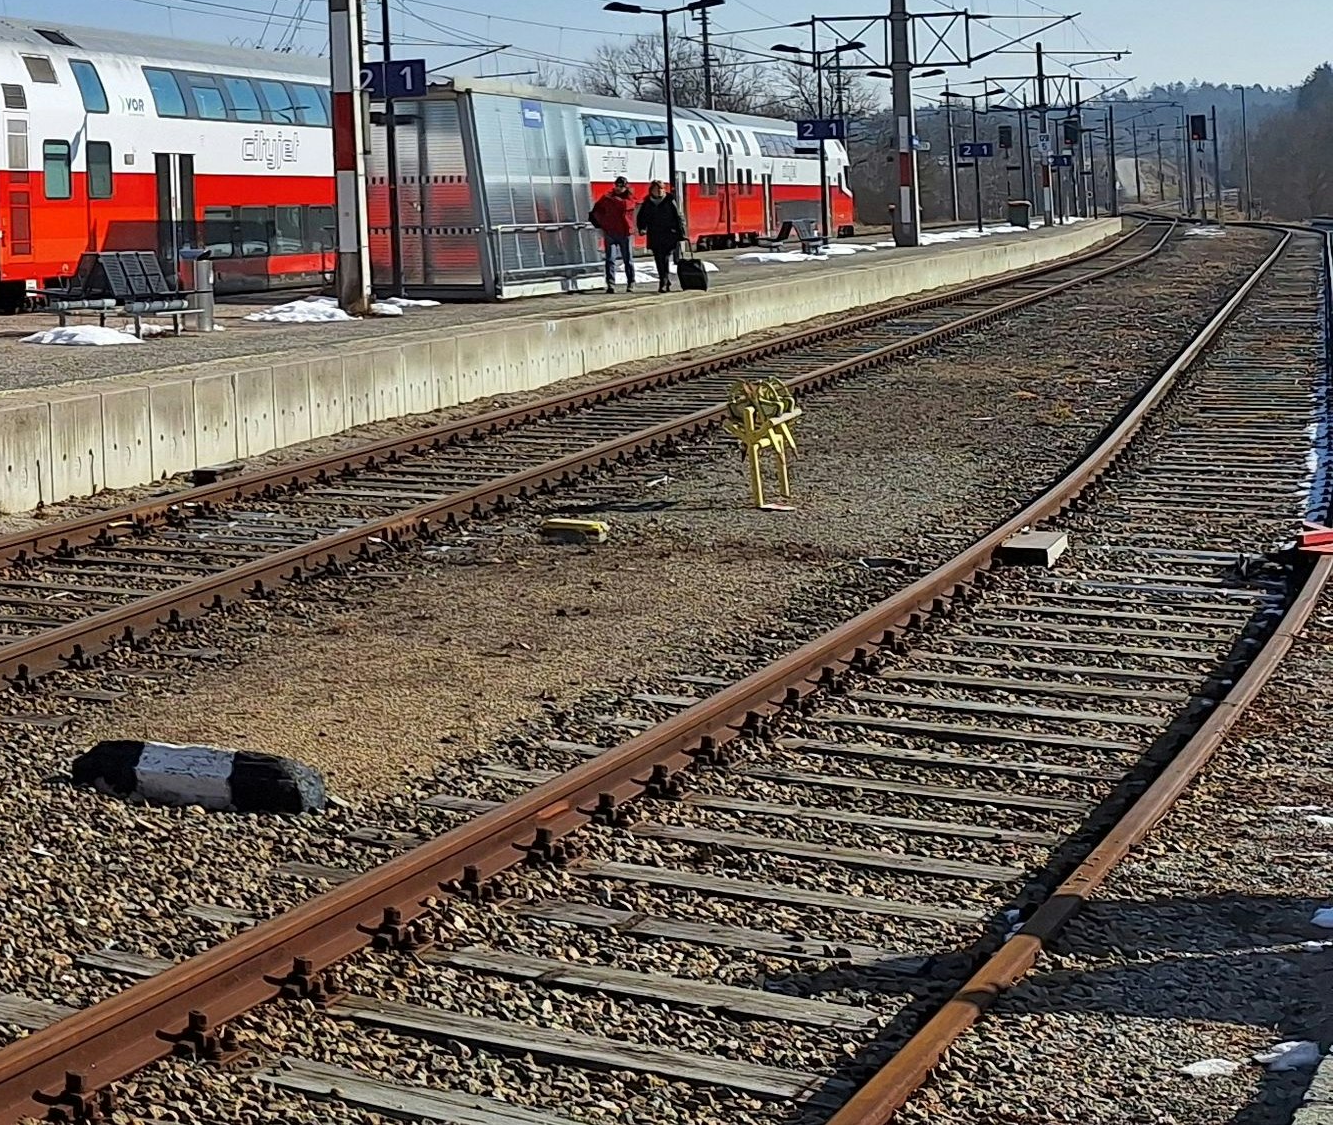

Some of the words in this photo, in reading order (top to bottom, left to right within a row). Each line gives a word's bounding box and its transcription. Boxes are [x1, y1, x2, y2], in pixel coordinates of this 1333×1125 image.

[360, 69, 374, 92] 2
[399, 66, 412, 90] 1
[125, 97, 145, 112] VOR
[803, 123, 814, 136] 2
[829, 123, 837, 136] 1
[242, 130, 300, 169] cityjet
[963, 145, 972, 155] 2
[982, 145, 988, 155] 1
